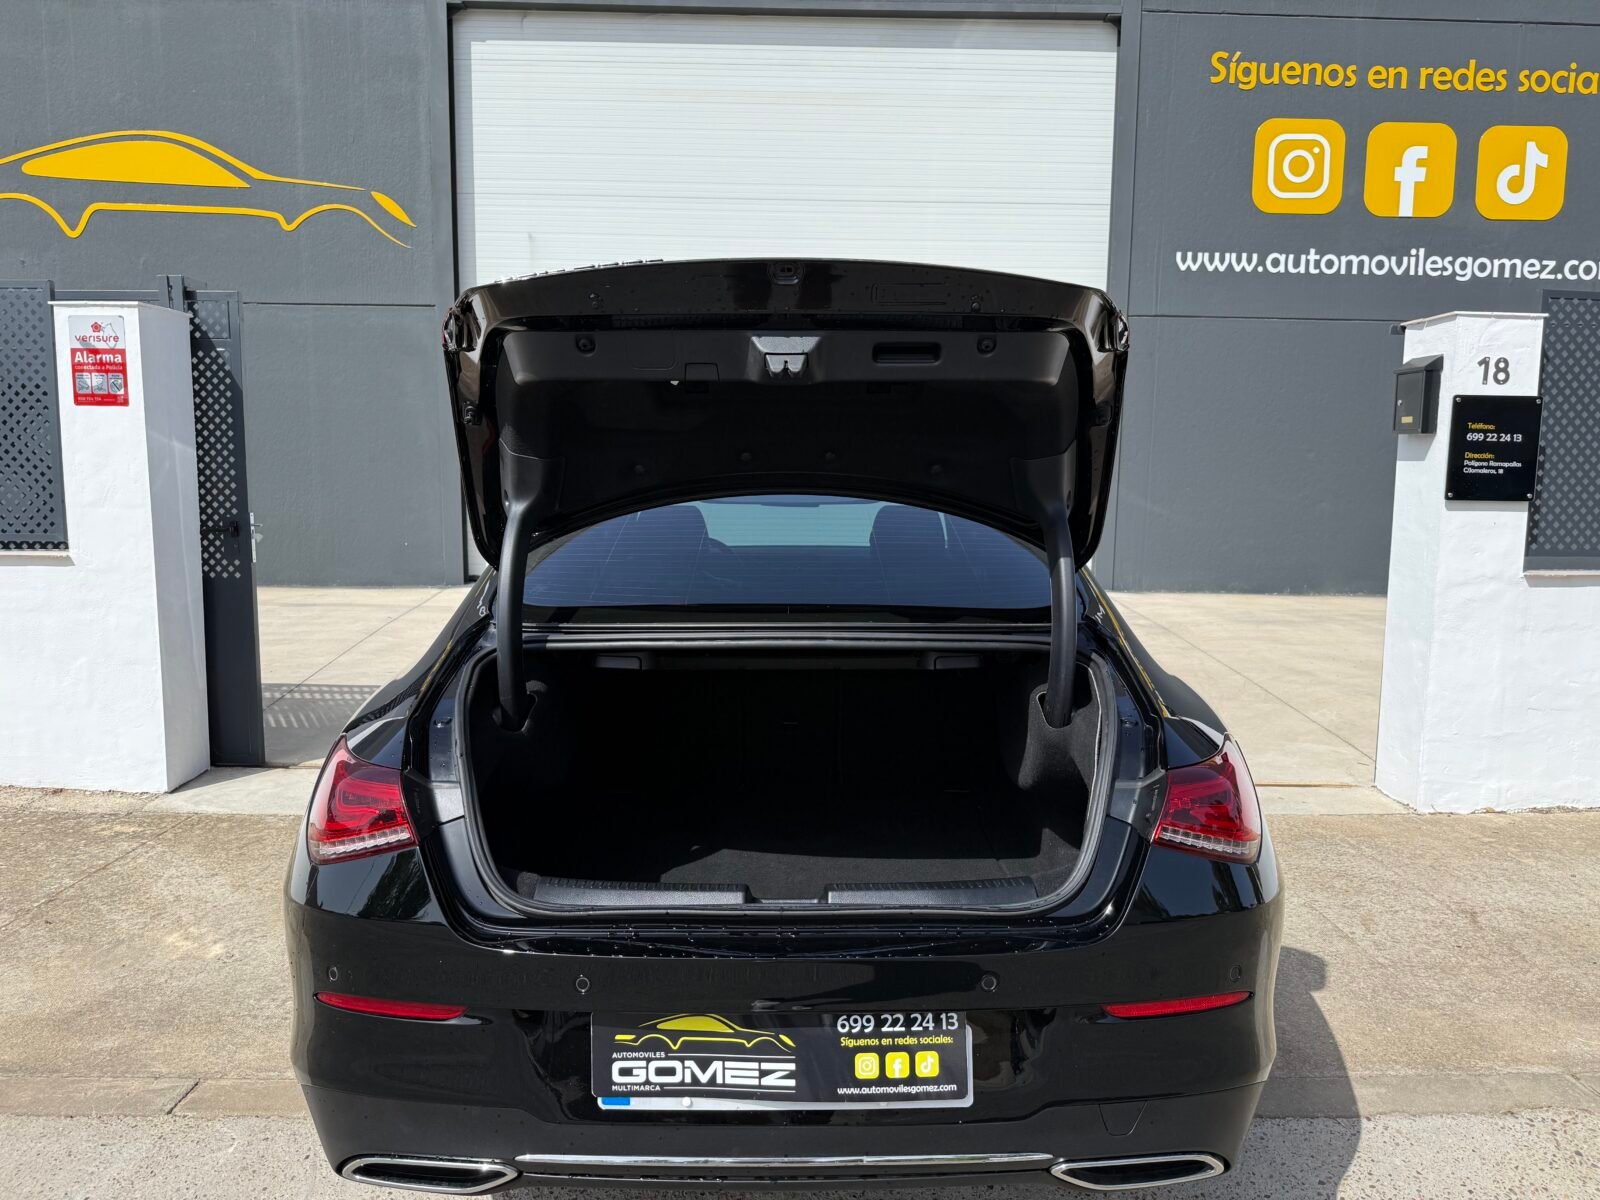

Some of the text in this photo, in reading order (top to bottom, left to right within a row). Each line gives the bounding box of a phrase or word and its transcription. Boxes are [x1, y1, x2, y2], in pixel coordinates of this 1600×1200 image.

[1208, 50, 1600, 95] Síguenos en redes socia
[1175, 247, 1600, 281] www.automovilesgomez.co
[74, 334, 120, 342] verisure
[74, 350, 122, 363] Alarma
[1477, 356, 1511, 385] 18
[1467, 422, 1496, 430] Teléfono:
[1466, 432, 1522, 442] 699 22 24 13
[1464, 451, 1495, 459] Dirección:
[836, 1012, 959, 1033] 699 22 24 13
[840, 1034, 954, 1048] Síguenos en redes sociales:
[612, 1051, 666, 1059] AUTOMOVILES
[611, 1060, 796, 1087] GOMEZ
[612, 1084, 661, 1092] MULTIMARCA
[837, 1083, 957, 1095] www.automovilesgomez.com
